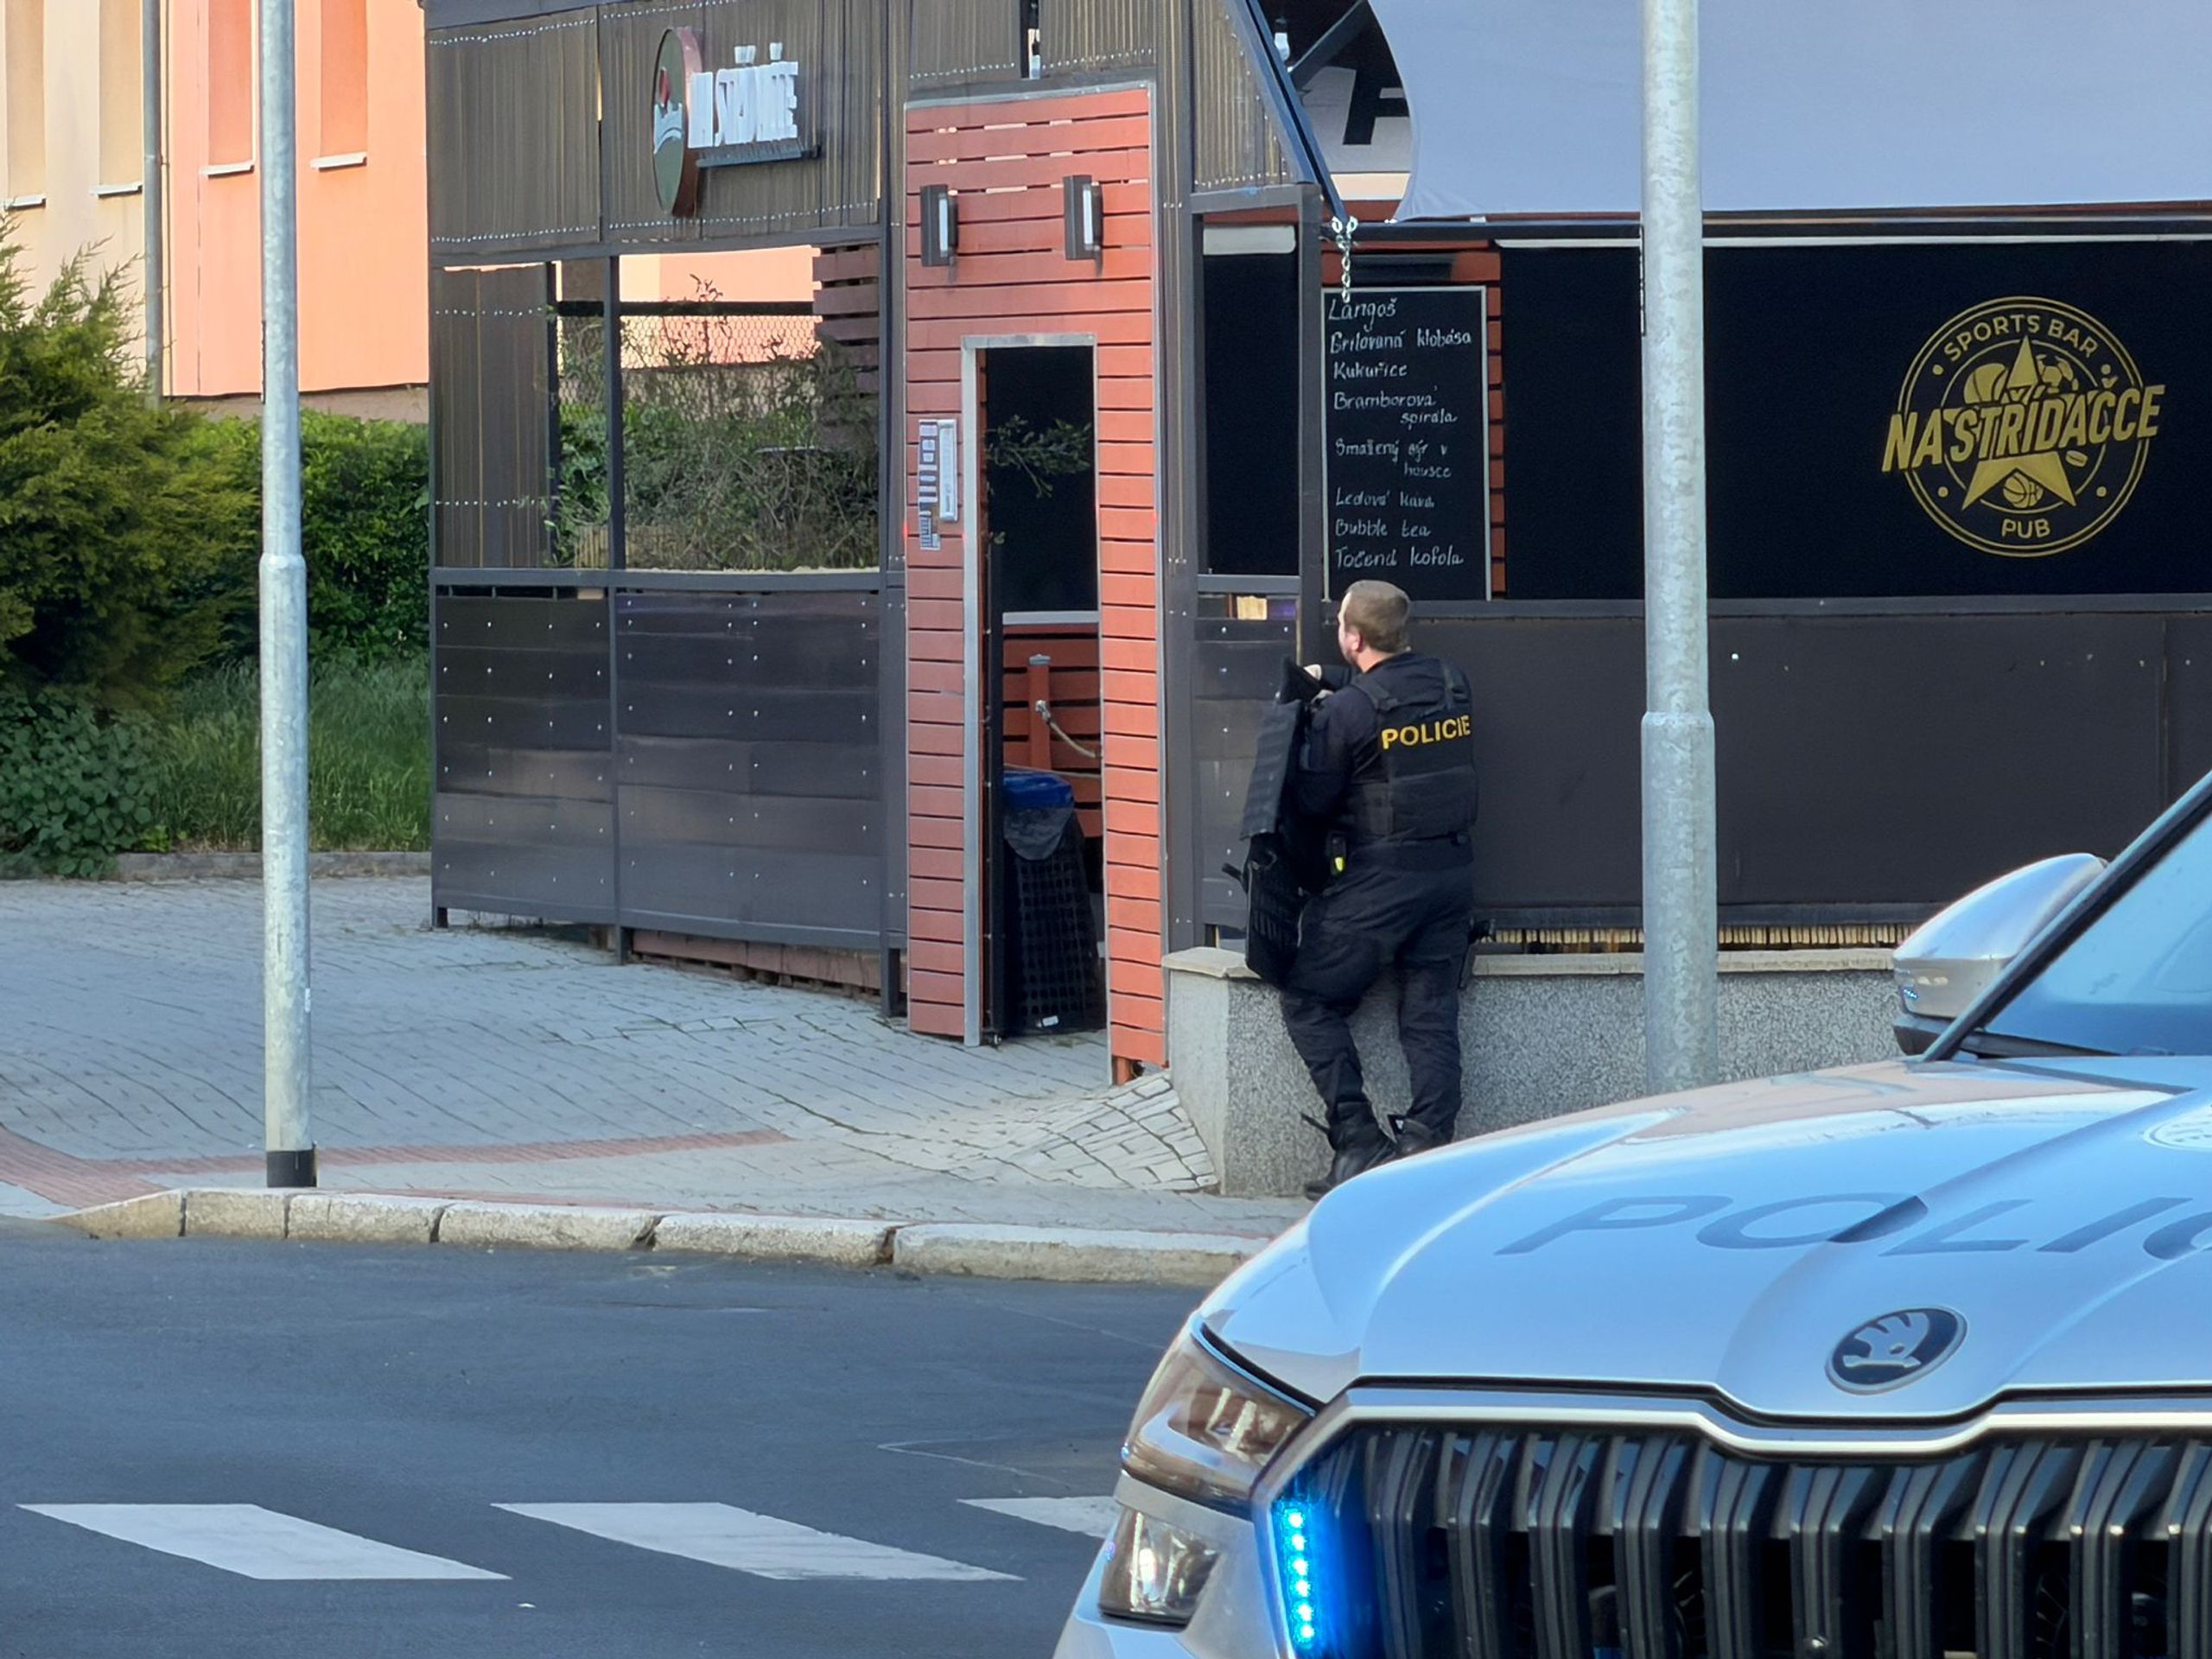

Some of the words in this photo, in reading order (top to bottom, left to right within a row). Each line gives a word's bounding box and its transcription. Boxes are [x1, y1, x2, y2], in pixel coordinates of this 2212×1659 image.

[1416, 327, 1472, 347] klobása
[1944, 313, 2041, 362] SPORTS
[2047, 318, 2099, 359] BAR
[1333, 360, 1408, 380] Kukuřice
[1333, 385, 1438, 410] Bramborová
[1403, 461, 1452, 479] housce
[1335, 518, 1389, 537] Bubble
[1401, 520, 1432, 537] tea
[2001, 518, 2051, 539] PUB
[1410, 544, 1465, 567] kofola
[1381, 715, 1471, 750] POLICIE
